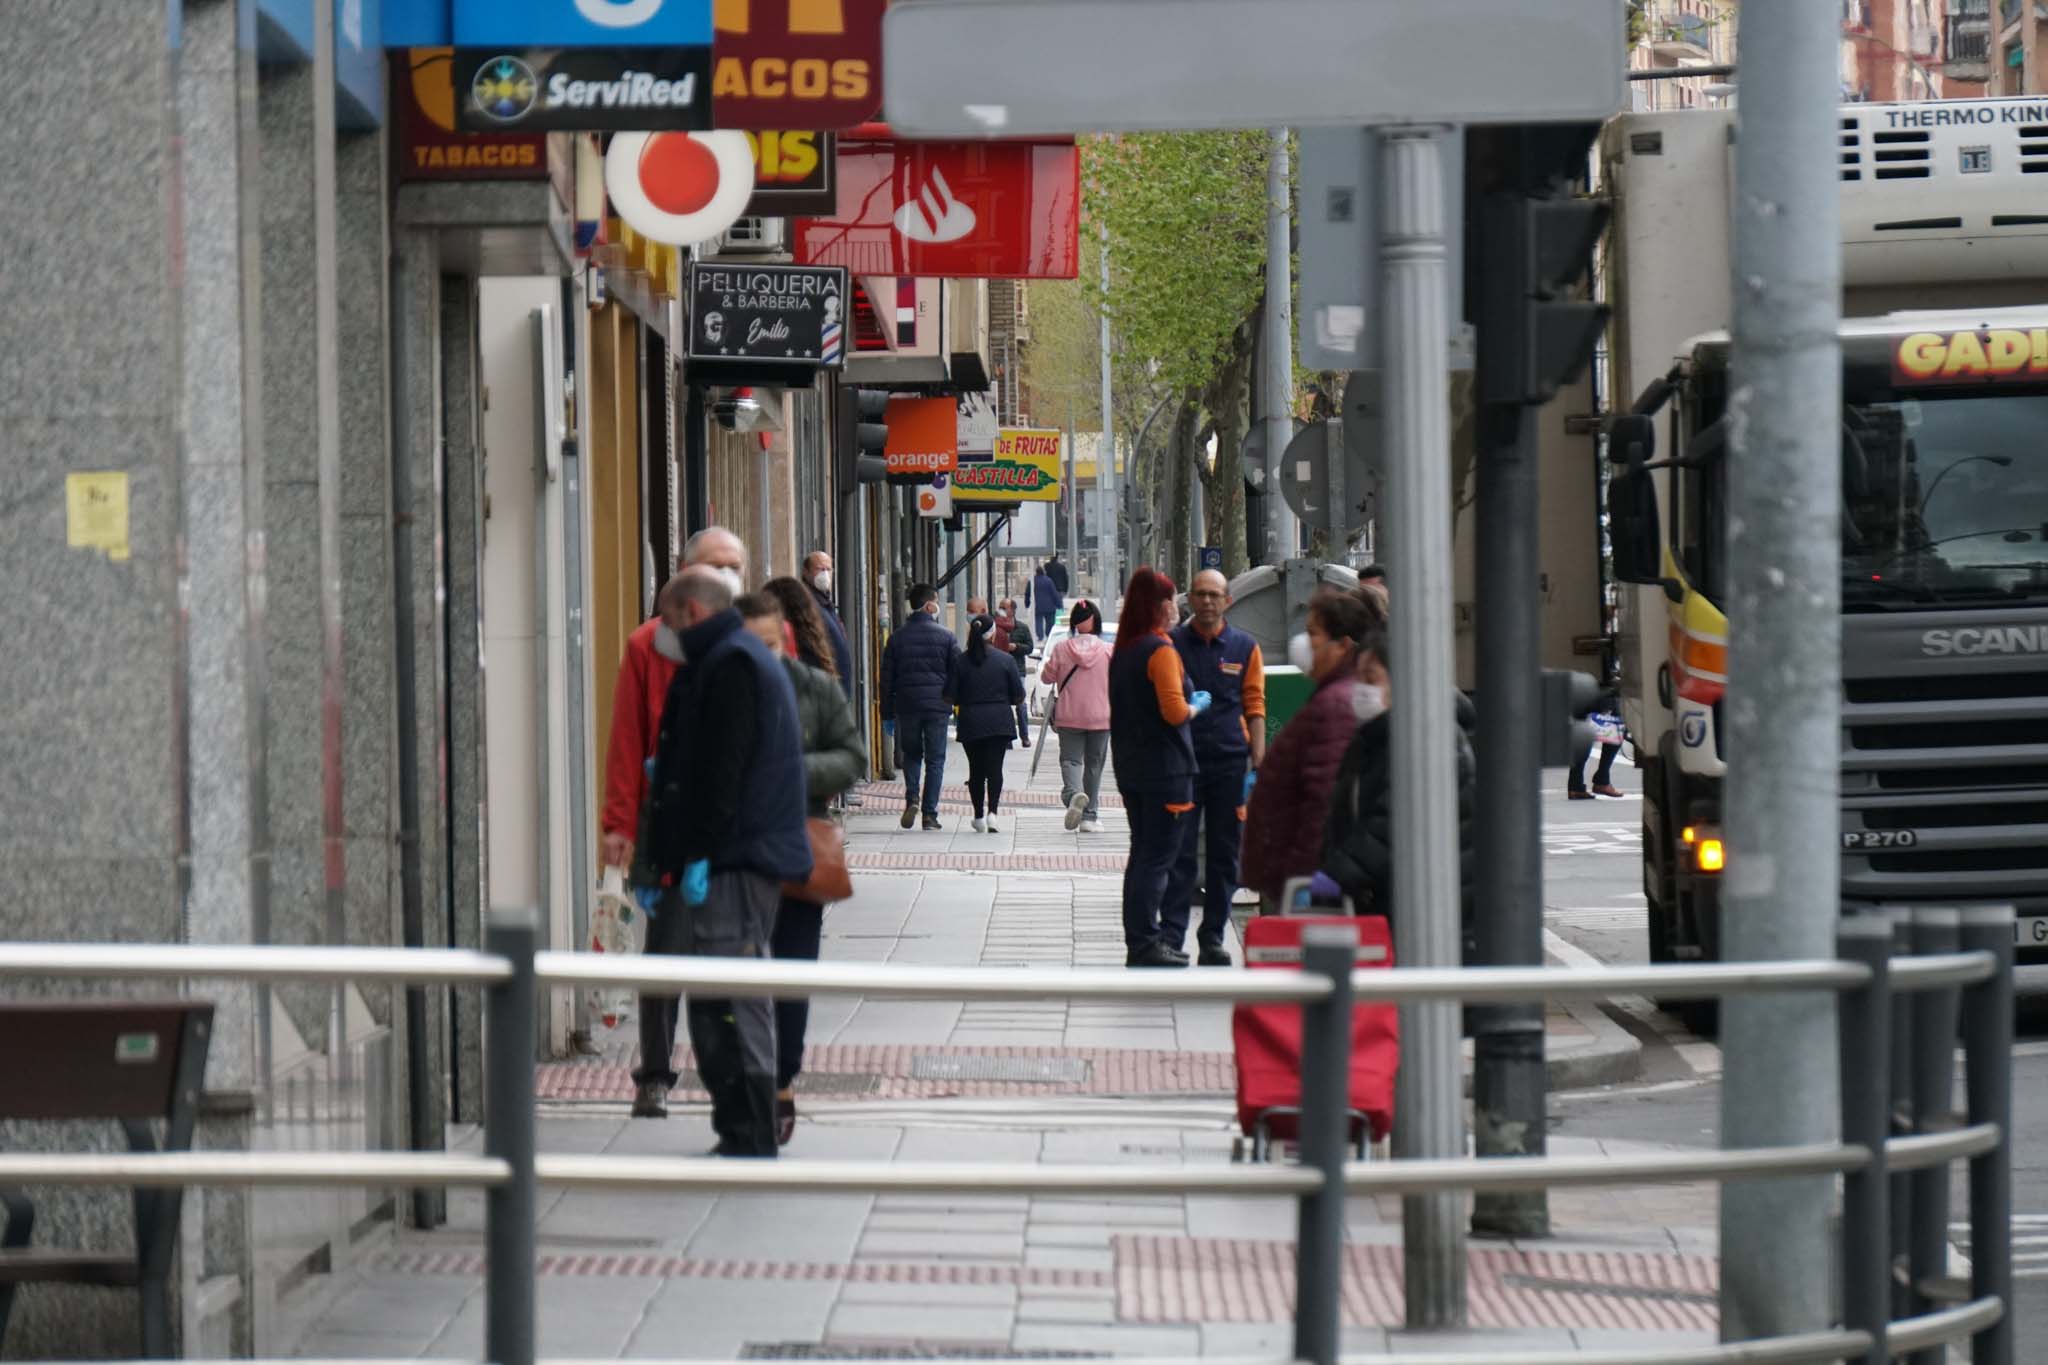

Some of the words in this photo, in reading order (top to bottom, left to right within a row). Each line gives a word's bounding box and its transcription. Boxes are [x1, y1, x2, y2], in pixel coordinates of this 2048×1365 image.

[546, 70, 695, 107] ServiRed
[1886, 108, 1994, 127] THERMO
[2001, 105, 2048, 123] KIN
[414, 144, 537, 168] TABACOS
[698, 272, 839, 295] PELUQUERIA
[722, 294, 733, 308] &
[738, 295, 811, 310] BARBERIA
[747, 317, 789, 344] Emilio
[999, 440, 1011, 454] DE
[1015, 435, 1059, 456] FRUTAS
[888, 452, 950, 469] orange
[955, 467, 1038, 486] CASTILLA
[1843, 832, 1861, 847] P
[1864, 830, 1914, 847] 270
